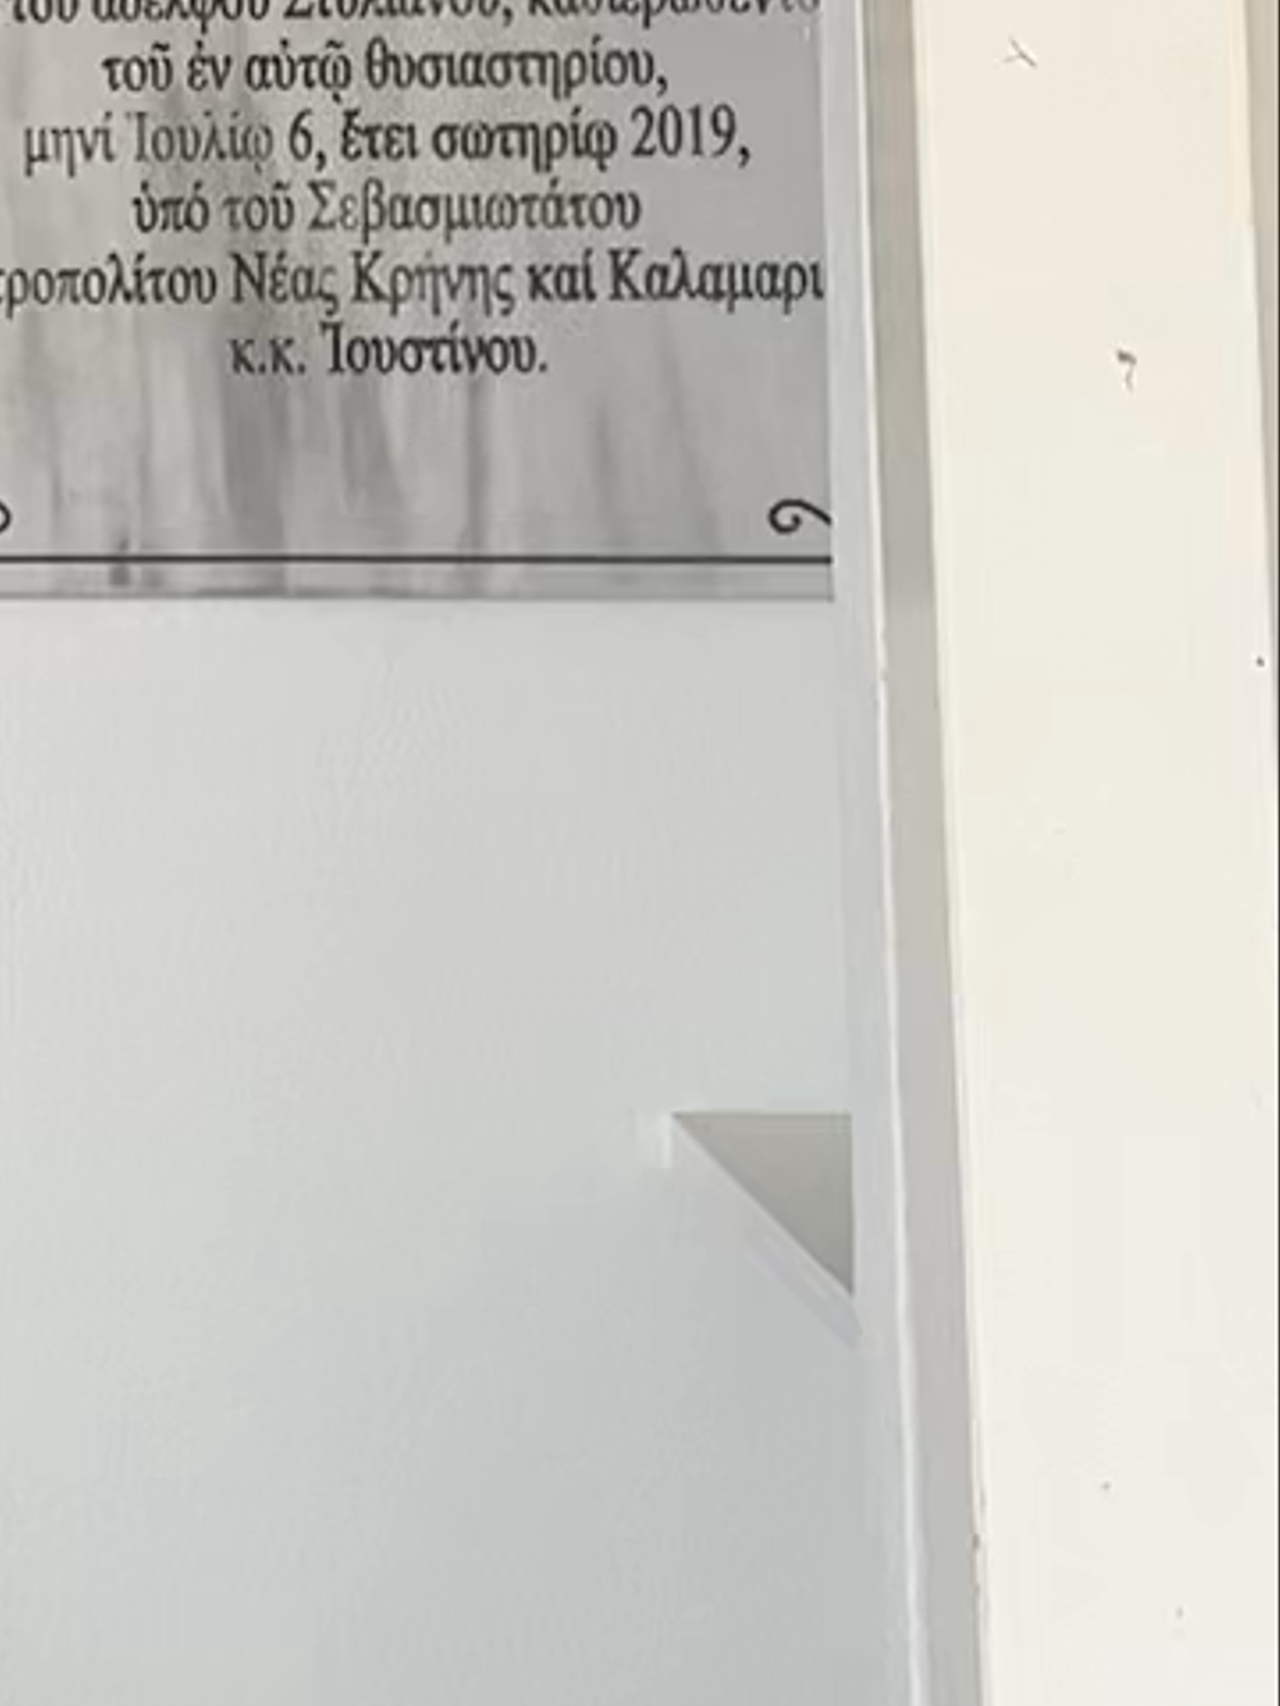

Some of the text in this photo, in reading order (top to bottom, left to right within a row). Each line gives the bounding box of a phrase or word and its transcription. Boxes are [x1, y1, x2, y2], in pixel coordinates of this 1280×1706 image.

[364, 32, 669, 100] θυσιαστηρίου,
[23, 112, 116, 178] μηνί
[288, 107, 328, 171] 6,
[630, 102, 751, 169] 2019,
[307, 174, 643, 246] Σεβασμιωτάτου
[231, 247, 339, 316] Νέας
[351, 247, 516, 317] Κρήνης
[526, 246, 598, 302] καί
[230, 336, 307, 376] κ.κ.
